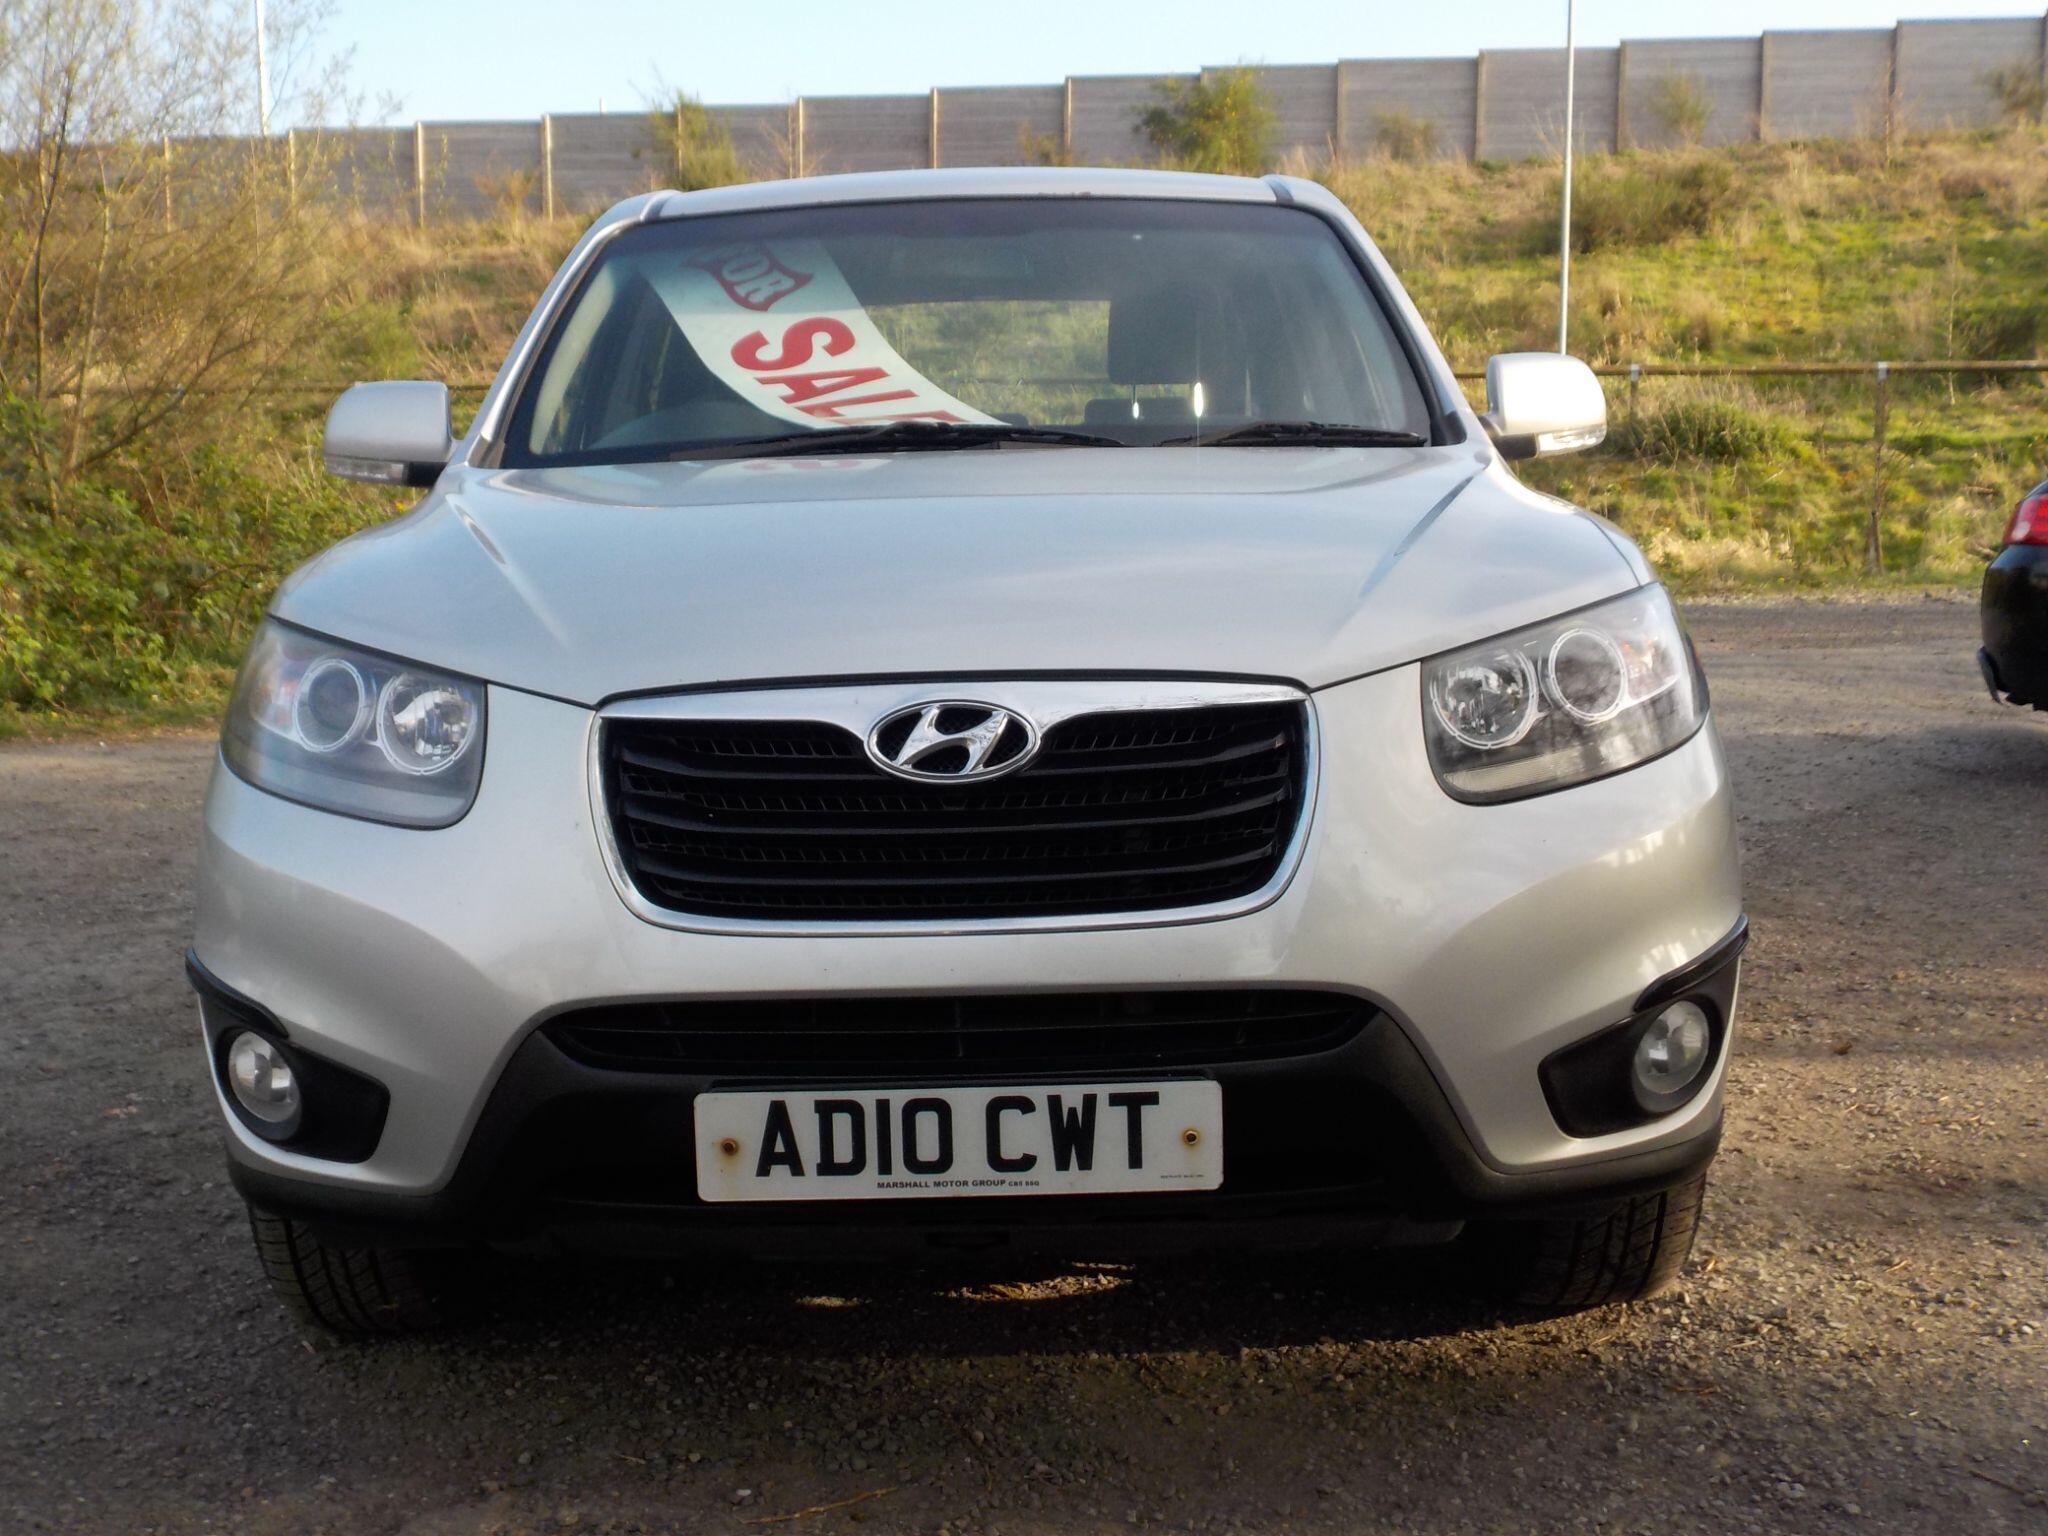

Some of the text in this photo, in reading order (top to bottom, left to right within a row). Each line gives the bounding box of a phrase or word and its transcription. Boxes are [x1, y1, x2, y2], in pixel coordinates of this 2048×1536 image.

[755, 1090, 1160, 1177] AD10 CWT
[877, 1180, 930, 1189] MARSHALL
[933, 1180, 969, 1188] MOTOR
[971, 1179, 1006, 1187] GROUP
